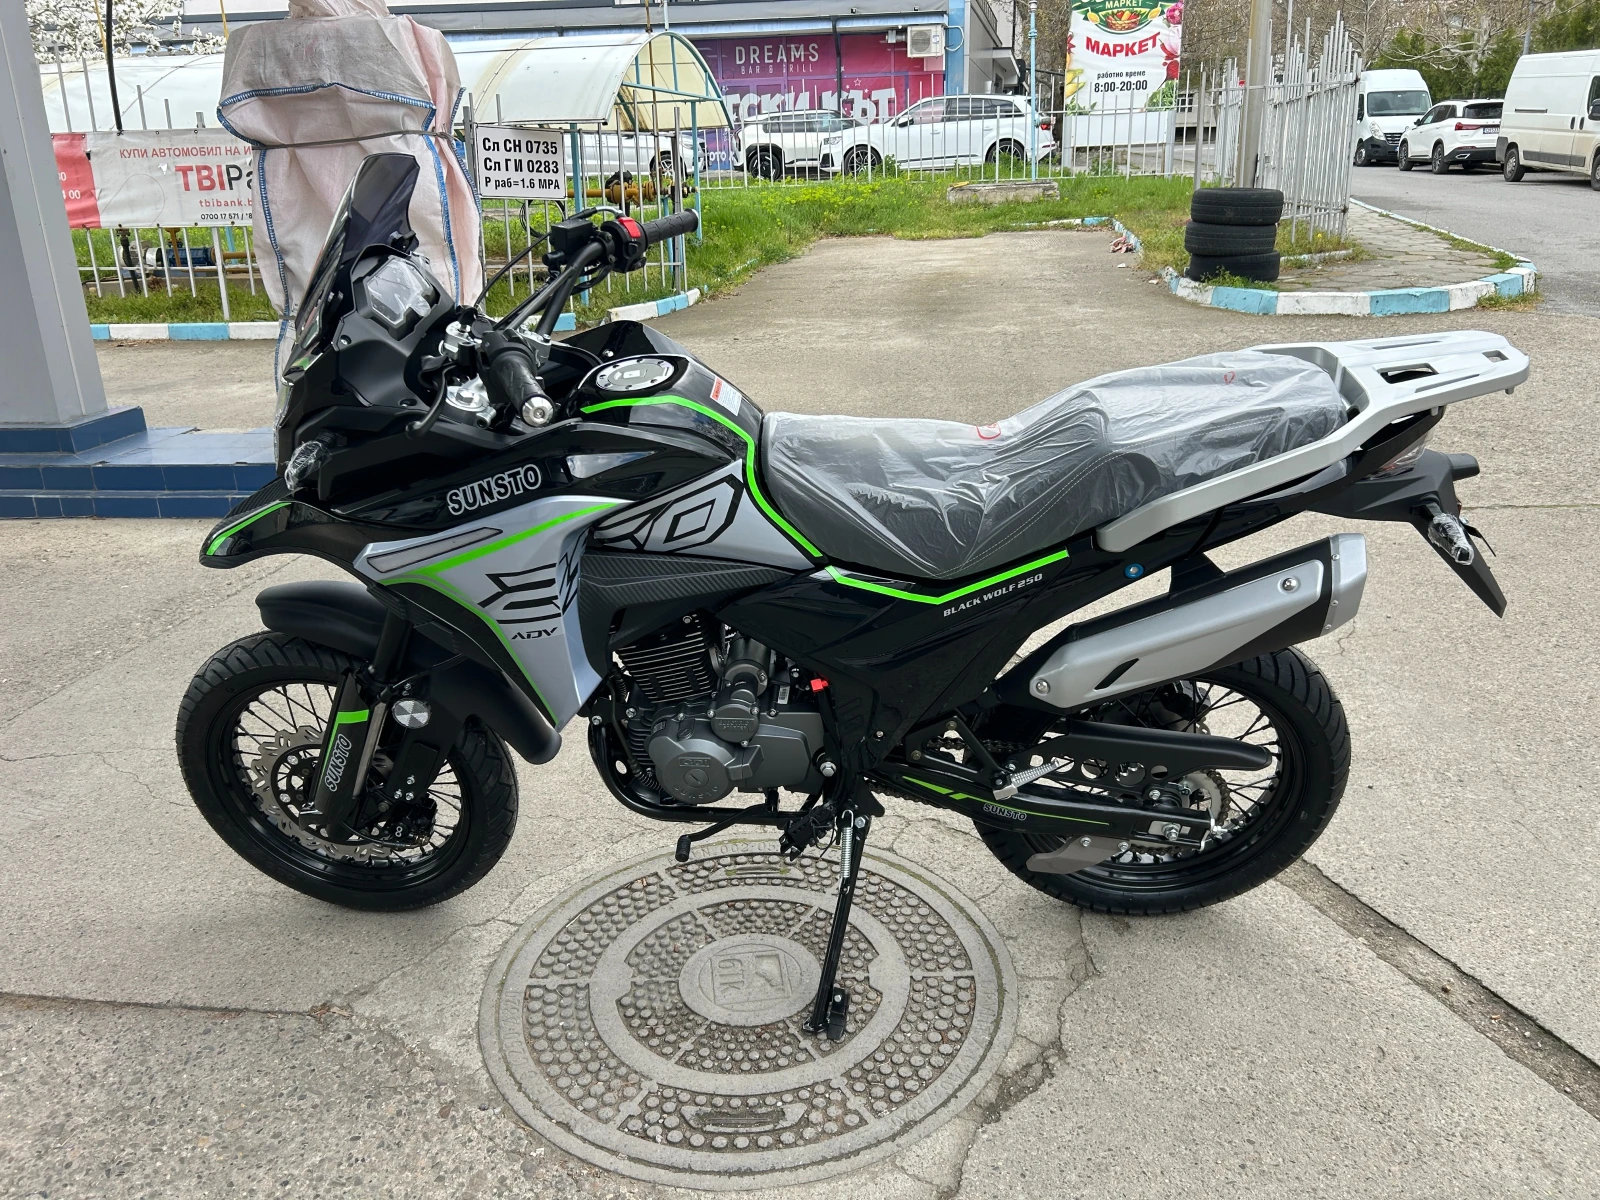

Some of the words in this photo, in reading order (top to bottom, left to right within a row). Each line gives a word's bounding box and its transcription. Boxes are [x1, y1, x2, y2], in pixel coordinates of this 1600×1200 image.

[1105, 0, 1142, 9] МАРКЕТ
[1085, 31, 1160, 57] МАРКЕТ
[736, 43, 819, 65] DREAMS
[741, 65, 760, 75] BAR
[1097, 71, 1124, 80] работно
[1125, 70, 1146, 78] време
[1094, 80, 1148, 93] 8:00-20:00
[120, 148, 148, 159] КУПИ
[151, 146, 222, 158] АВТОМОБИЛ
[225, 146, 241, 156] НА
[482, 137, 500, 152] Сл
[503, 139, 522, 153] СН
[525, 140, 558, 155] 0735
[483, 157, 501, 171] Сл
[526, 159, 559, 174] 0283
[484, 176, 492, 187] Р
[447, 464, 541, 515] SUNSTO
[943, 597, 981, 617] BLACK
[983, 583, 1016, 601] WOLF
[1017, 573, 1043, 589] 250
[511, 627, 558, 640] ADV
[325, 734, 352, 792] SUNSTO
[983, 803, 1028, 821] SUNSTO
